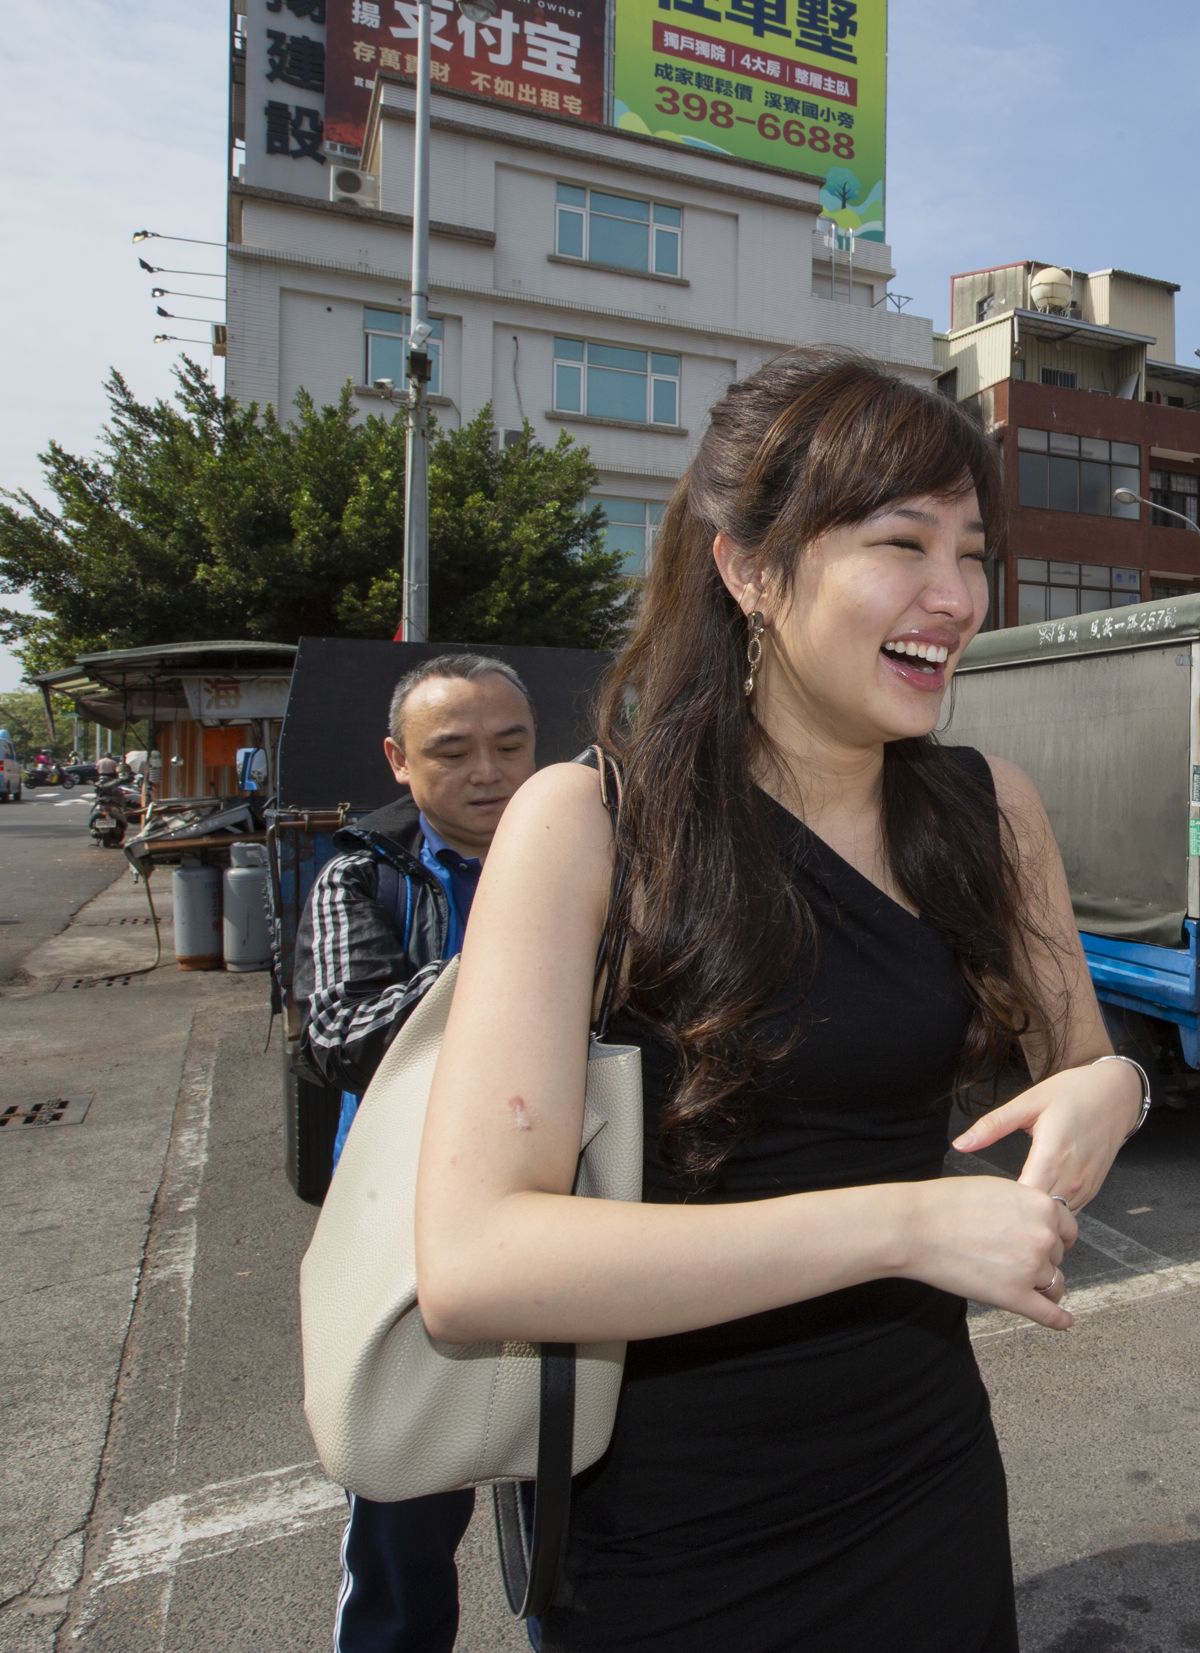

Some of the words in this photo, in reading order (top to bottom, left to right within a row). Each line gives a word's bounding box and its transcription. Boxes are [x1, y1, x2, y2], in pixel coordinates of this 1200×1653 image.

[537, 0, 582, 18] owner
[654, 62, 753, 103] 成家輕鬆價
[663, 30, 726, 63] 獨戶獨院
[740, 55, 781, 78] 4大房
[794, 67, 850, 97] 整層主臥
[470, 71, 582, 115] 不如出租宅
[654, 86, 855, 160] 398-6688
